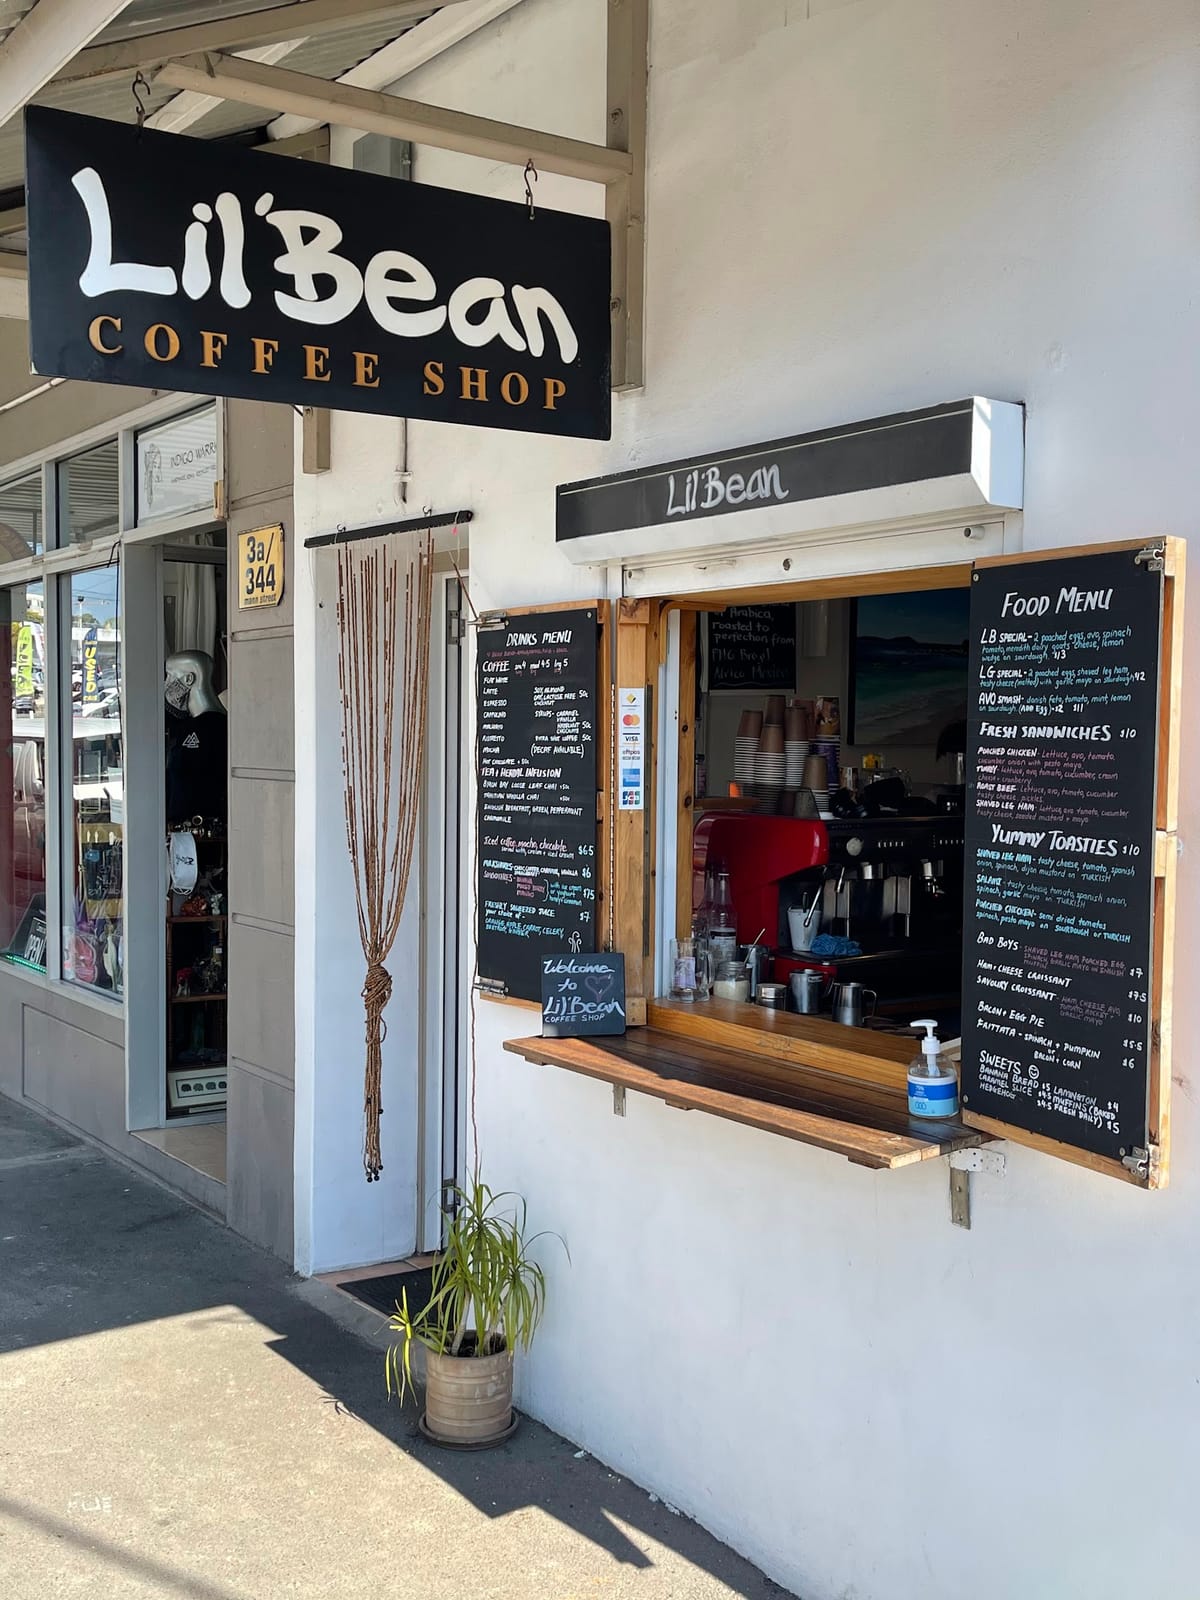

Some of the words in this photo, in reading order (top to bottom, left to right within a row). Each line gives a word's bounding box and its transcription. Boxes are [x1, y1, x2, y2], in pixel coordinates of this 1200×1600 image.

[88, 315, 382, 388] COFFEE
[424, 360, 568, 410] SHOP
[247, 532, 274, 564] 3a/
[246, 564, 276, 594] 344
[1001, 592, 1050, 618] FOOD
[1055, 586, 1113, 614] MENU
[712, 621, 752, 631] roasted
[757, 622, 770, 632] to
[981, 628, 997, 644] LB
[1034, 633, 1039, 642] 2
[1041, 630, 1068, 645] poached
[1102, 625, 1132, 638] spinach
[506, 632, 537, 647] DRINKS
[542, 630, 572, 644] MENU
[771, 634, 795, 646] from
[1102, 638, 1124, 648] lemon
[482, 661, 510, 672] COFFEE
[982, 654, 1000, 664] wedge
[85, 647, 97, 692] USED
[980, 666, 996, 678] LG
[1035, 667, 1060, 681] poached
[1077, 666, 1099, 675] shaved
[1102, 667, 1112, 677] leg
[1055, 677, 1074, 689] garlic
[1075, 677, 1092, 687] mayo
[979, 692, 996, 705] AVO
[979, 721, 1017, 739] FRESH
[1021, 724, 1112, 742] SANDWICHES
[481, 767, 494, 777] TEA
[525, 767, 561, 777] INFUSION
[976, 782, 996, 791] ROAST
[997, 783, 1017, 793] BEEF
[976, 800, 1000, 809] SHAVED
[1001, 801, 1015, 810] LEG
[484, 836, 499, 845] Iced
[1048, 830, 1118, 857] TOASTIES
[976, 848, 1001, 860] SHAVED
[1001, 851, 1014, 862] LEG
[582, 867, 591, 878] $6
[1021, 864, 1037, 877] dijon
[1039, 867, 1067, 878] mustard
[1081, 873, 1111, 883] TURKISH
[1038, 854, 1055, 868] tasty
[1056, 858, 1080, 872] cheese,
[1111, 865, 1136, 878] spanish
[976, 899, 1002, 912] POACHED
[1002, 889, 1021, 899] garlic
[1023, 891, 1040, 902] mayo
[1056, 896, 1086, 908] TURKISH
[485, 901, 507, 910] FRESHLY
[510, 904, 536, 913] SQUEEZED
[580, 912, 591, 922] $7
[1038, 911, 1054, 921] semi
[1056, 914, 1076, 927] dried
[1055, 924, 1090, 937] SOURDOUGH
[1103, 932, 1131, 944] TURKISH
[977, 931, 994, 945] BAD
[997, 936, 1019, 950] BOYS
[1130, 968, 1143, 978] $7
[544, 959, 615, 974] Welcome
[998, 965, 1024, 978] CHEESE
[1027, 972, 1072, 987] CROISSANT
[558, 978, 577, 992] to
[976, 975, 1009, 991] SAVOURY
[1011, 983, 1057, 1001] CROISSANT
[1128, 1013, 1142, 1023] $10
[582, 1013, 605, 1021] SHOP
[977, 1001, 1001, 1017] BACON
[1009, 1009, 1027, 1022] EGG
[1029, 1014, 1045, 1028] PIE
[976, 1018, 1016, 1036] FRITTATA
[1024, 1033, 1053, 1048] SPINACH
[1064, 1043, 1101, 1059] PUMPKIN
[1122, 1058, 1135, 1069] $6
[979, 1050, 1021, 1075] SWEETS
[1034, 1051, 1055, 1063] BACON
[1062, 1059, 1081, 1070] CORN
[978, 1073, 1009, 1088] CARAMEL
[1012, 1084, 1033, 1096] SLICE
[1053, 1096, 1087, 1113] MUFFINS
[979, 1065, 1009, 1080] BANANA
[1012, 1075, 1039, 1089] BREAD
[1053, 1086, 1097, 1106] LAMINGTON
[1107, 1101, 1119, 1113] $4
[1054, 1104, 1076, 1117] FRESH
[1107, 1121, 1120, 1134] $5
